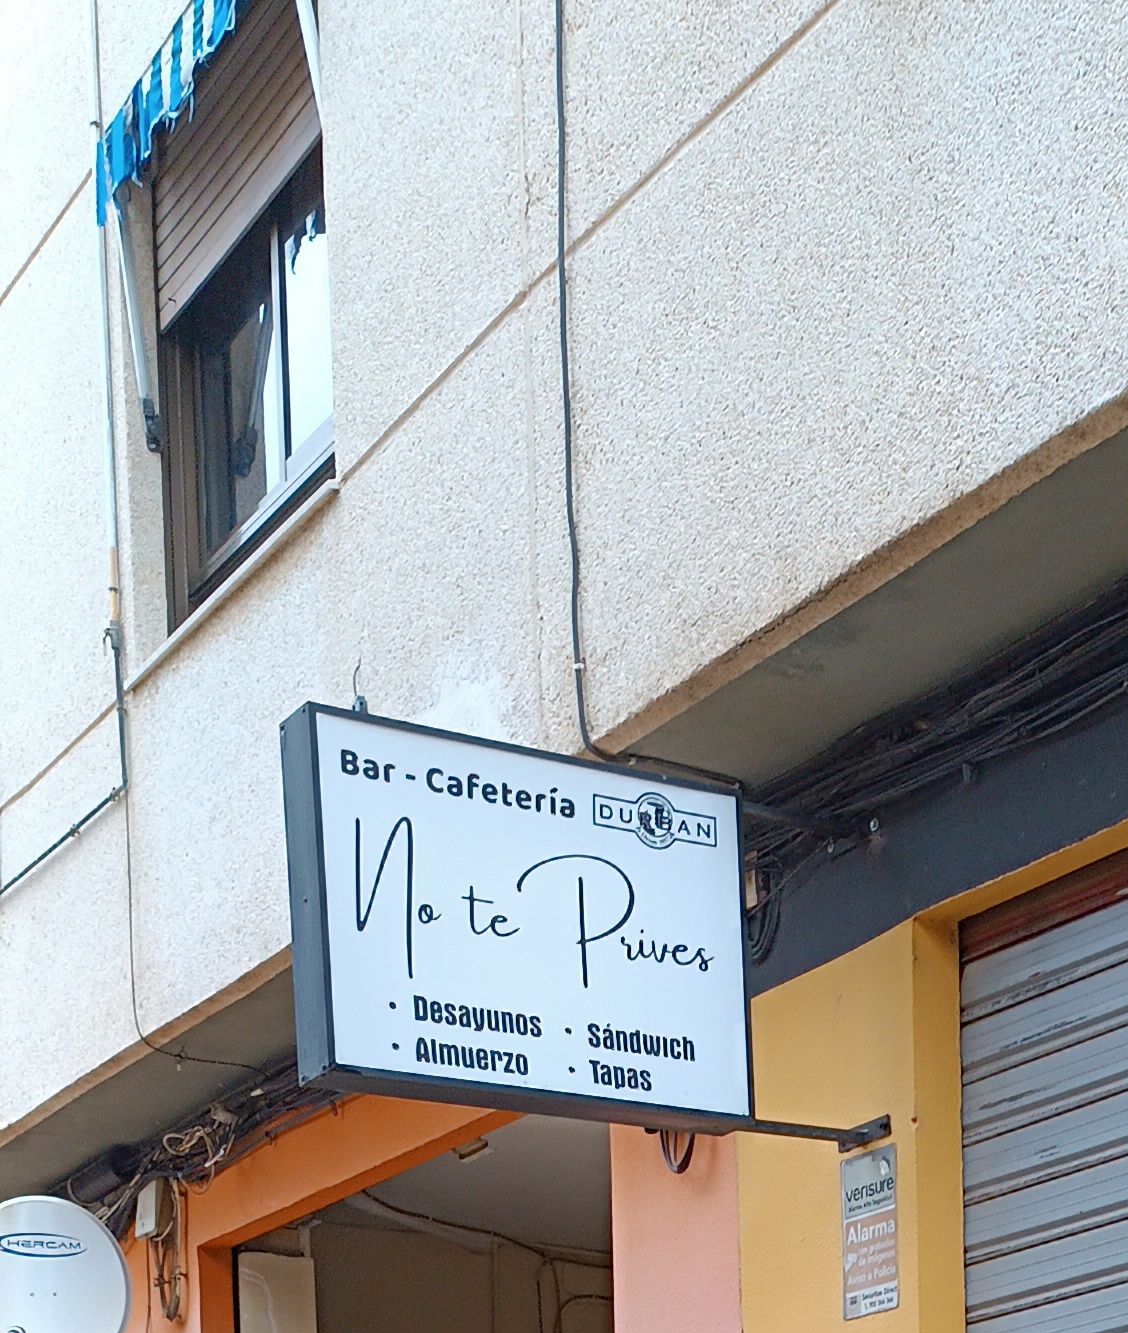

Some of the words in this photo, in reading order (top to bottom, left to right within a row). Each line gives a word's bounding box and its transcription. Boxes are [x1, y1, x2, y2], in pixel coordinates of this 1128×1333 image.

[340, 749, 396, 783] Bar
[426, 767, 576, 818] Cafetería
[355, 817, 442, 979] No
[461, 885, 520, 937] te
[517, 854, 715, 988] Prives
[413, 995, 543, 1037] Desayunos
[416, 1037, 530, 1076] Almuerzo
[587, 1022, 696, 1062] Sándwich
[589, 1059, 653, 1091] Tapas
[845, 1176, 895, 1203] verisure
[7, 1239, 82, 1249] HERCAM
[847, 1219, 896, 1246] Alarma
